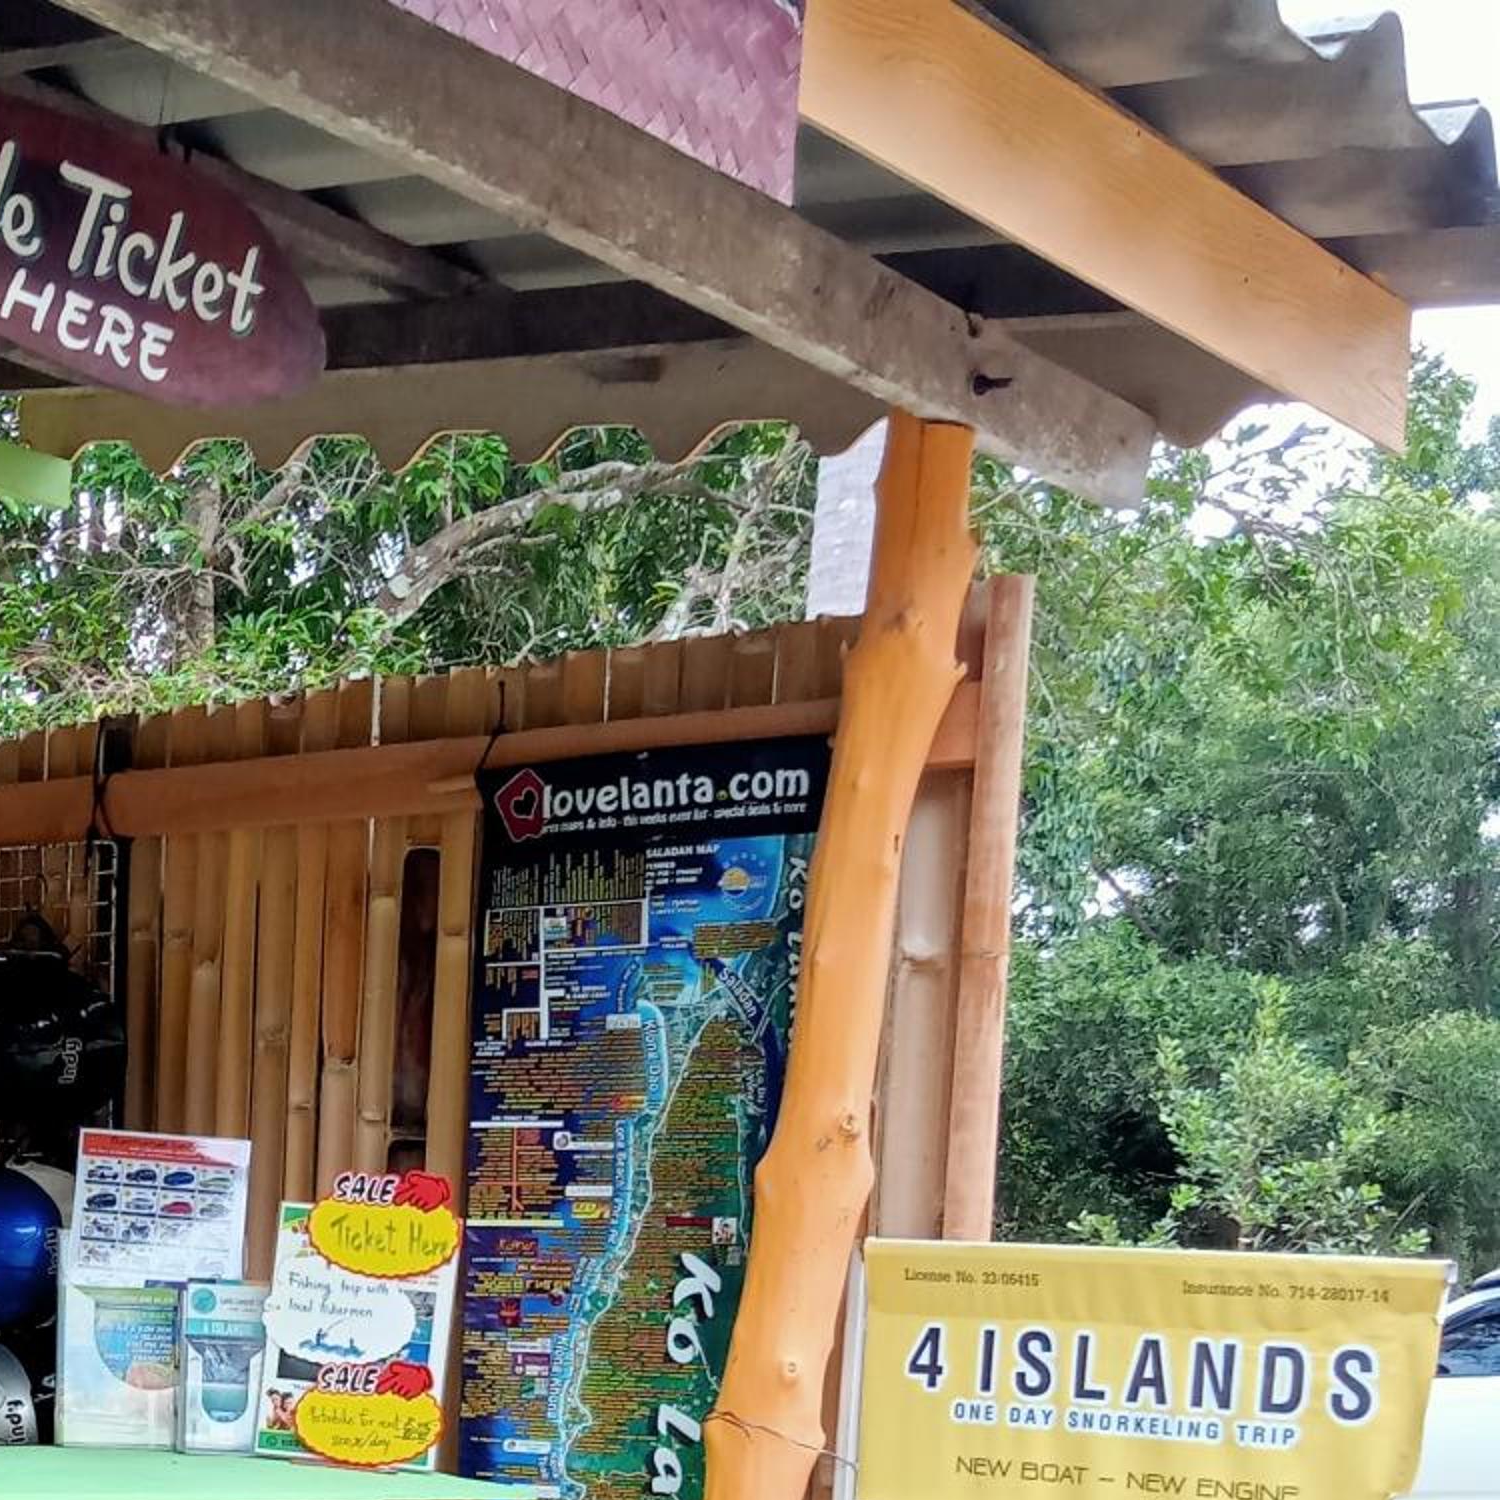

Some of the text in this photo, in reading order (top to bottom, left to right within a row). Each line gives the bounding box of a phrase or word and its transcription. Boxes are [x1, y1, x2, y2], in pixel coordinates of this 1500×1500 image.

[58, 160, 265, 334] Ticket
[0, 267, 176, 383] HERE
[541, 767, 811, 820] lovelanta.com
[335, 1173, 397, 1204] SALE
[330, 1212, 397, 1256] Ticket
[903, 1268, 951, 1283] License
[1182, 1279, 1253, 1298] Insurance
[667, 1252, 722, 1364] Ko
[320, 1365, 381, 1394] SALE
[907, 1325, 1374, 1422] 4 ISLANDS
[953, 1402, 1296, 1445] ONE DAY SNORKELING TRIP
[955, 1455, 1014, 1479] NEW
[1020, 1461, 1090, 1485] BOAT
[1125, 1471, 1187, 1495] NEW
